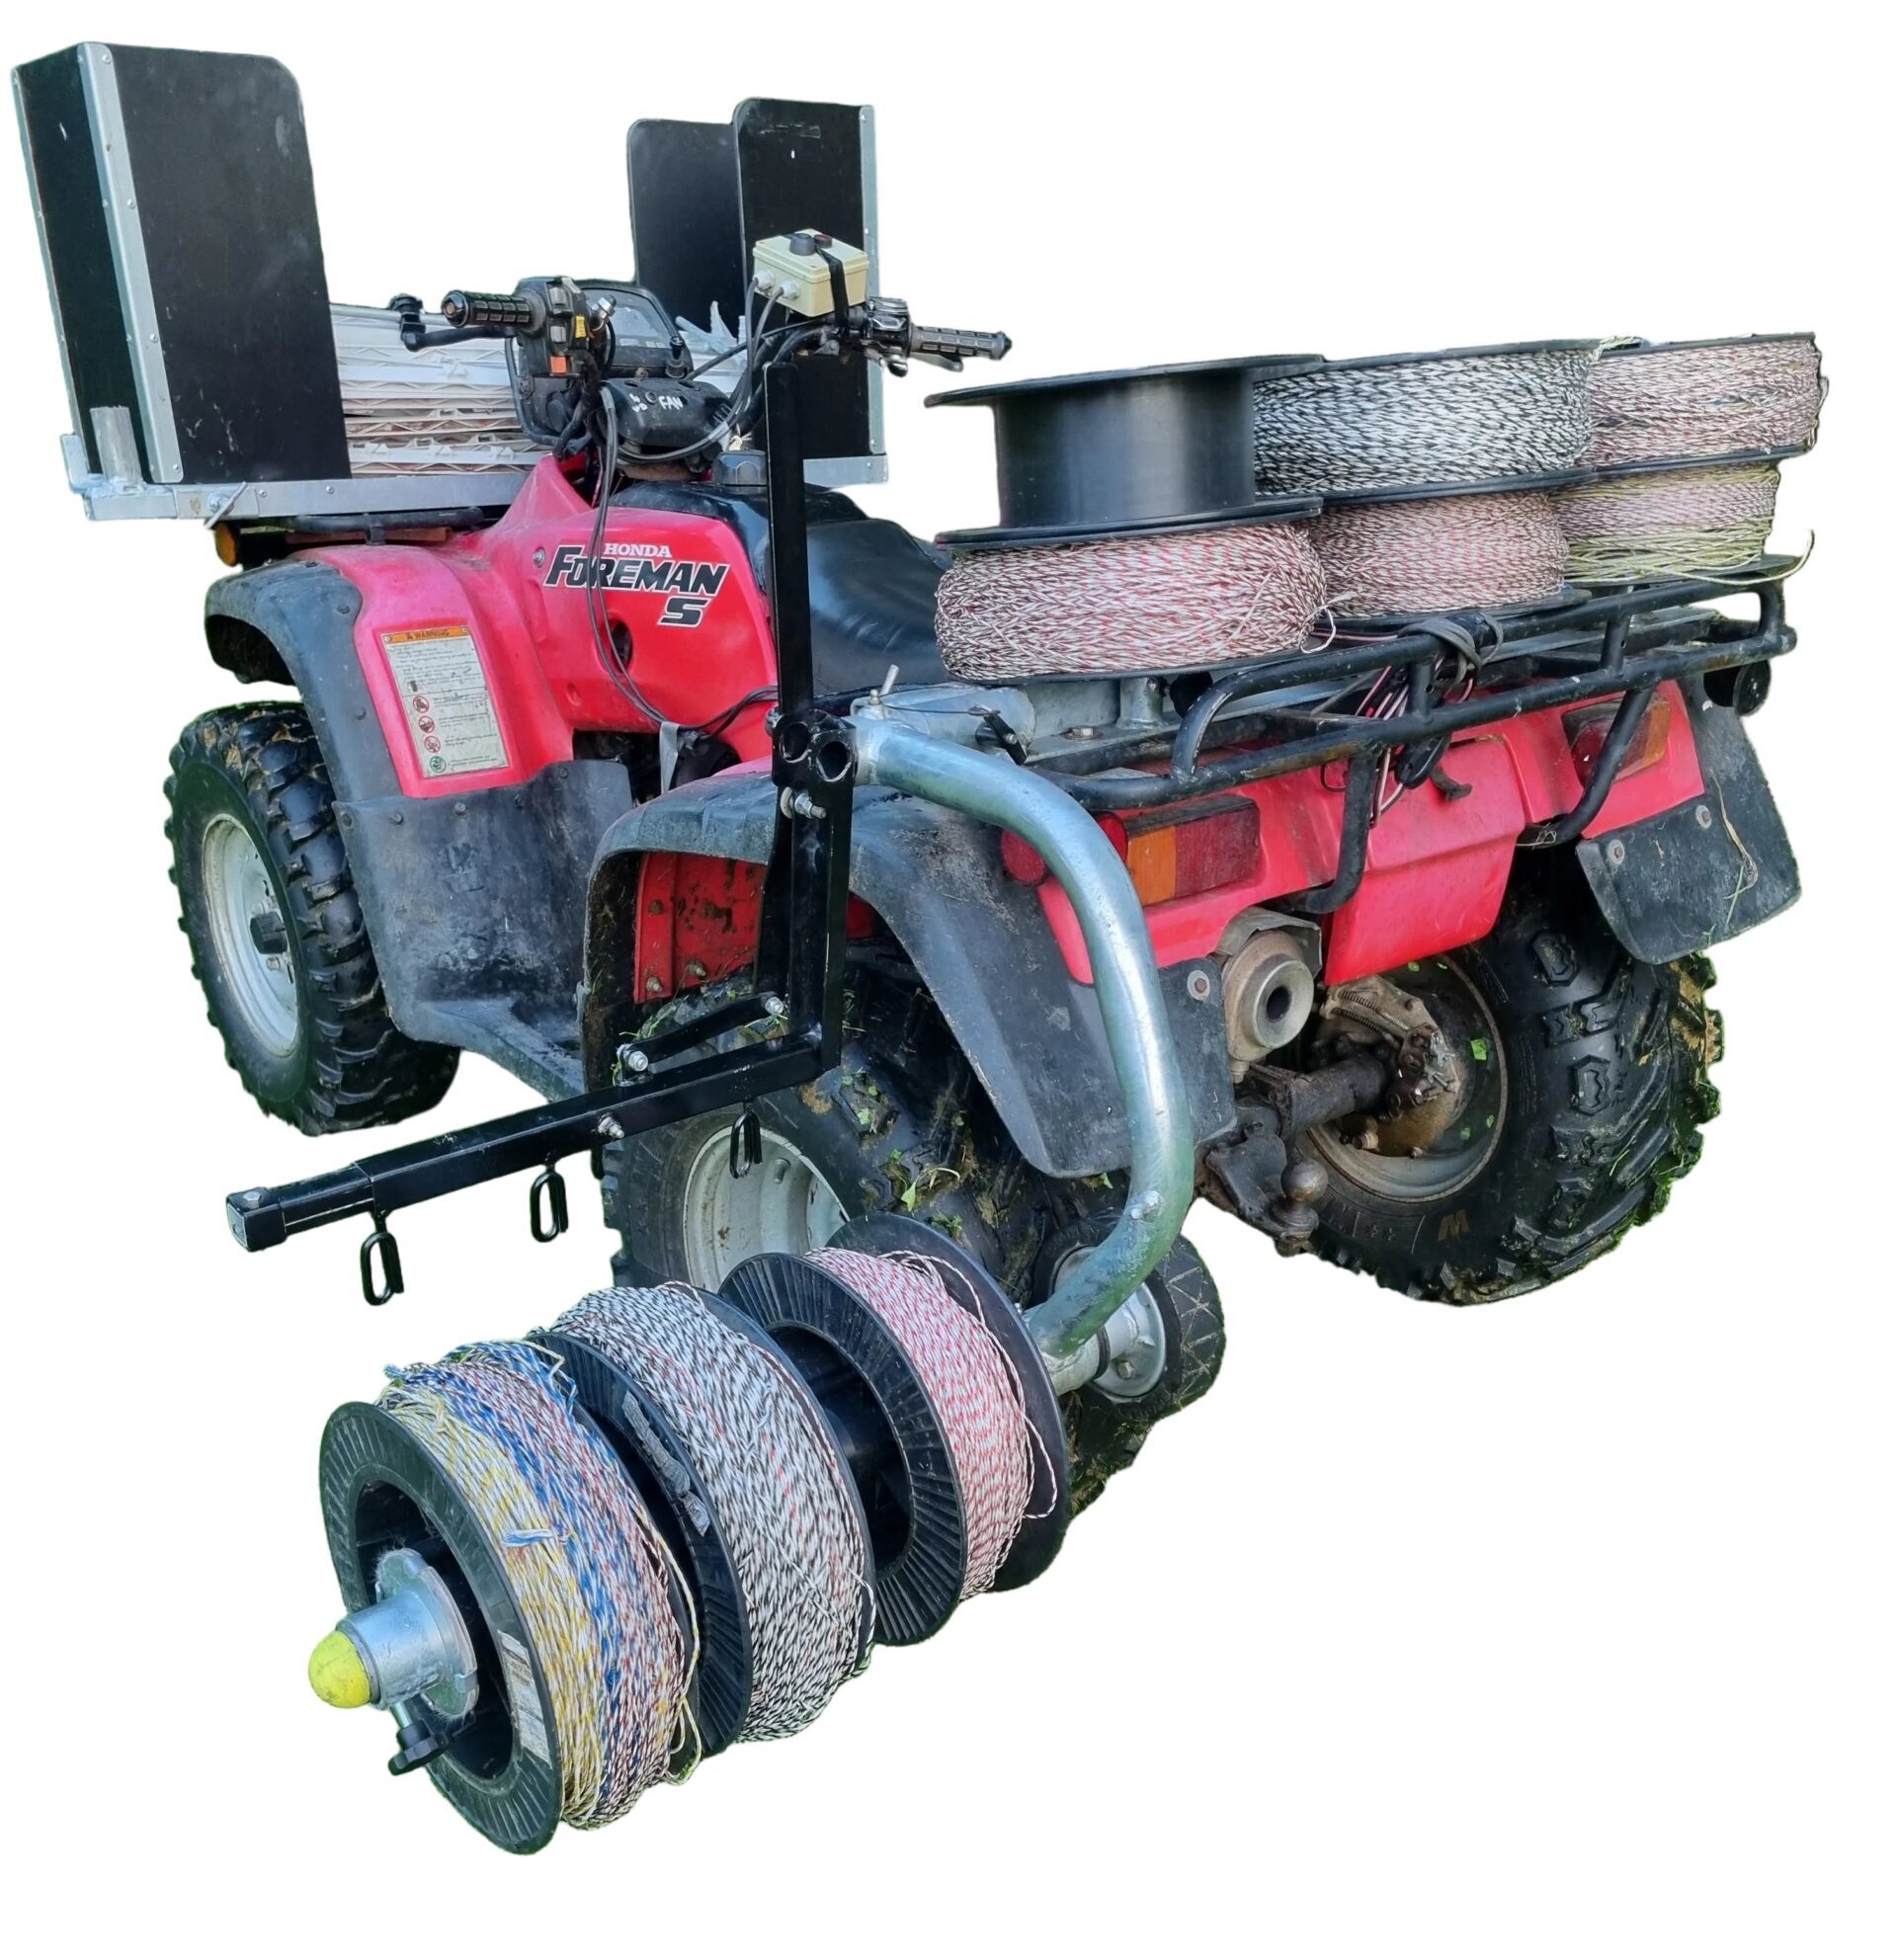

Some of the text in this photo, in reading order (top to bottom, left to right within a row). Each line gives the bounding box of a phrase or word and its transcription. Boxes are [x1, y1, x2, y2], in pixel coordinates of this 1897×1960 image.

[658, 395, 684, 411] FAN
[605, 543, 672, 558] HONDA
[544, 545, 730, 596] FOREMAN
[656, 595, 712, 628] S
